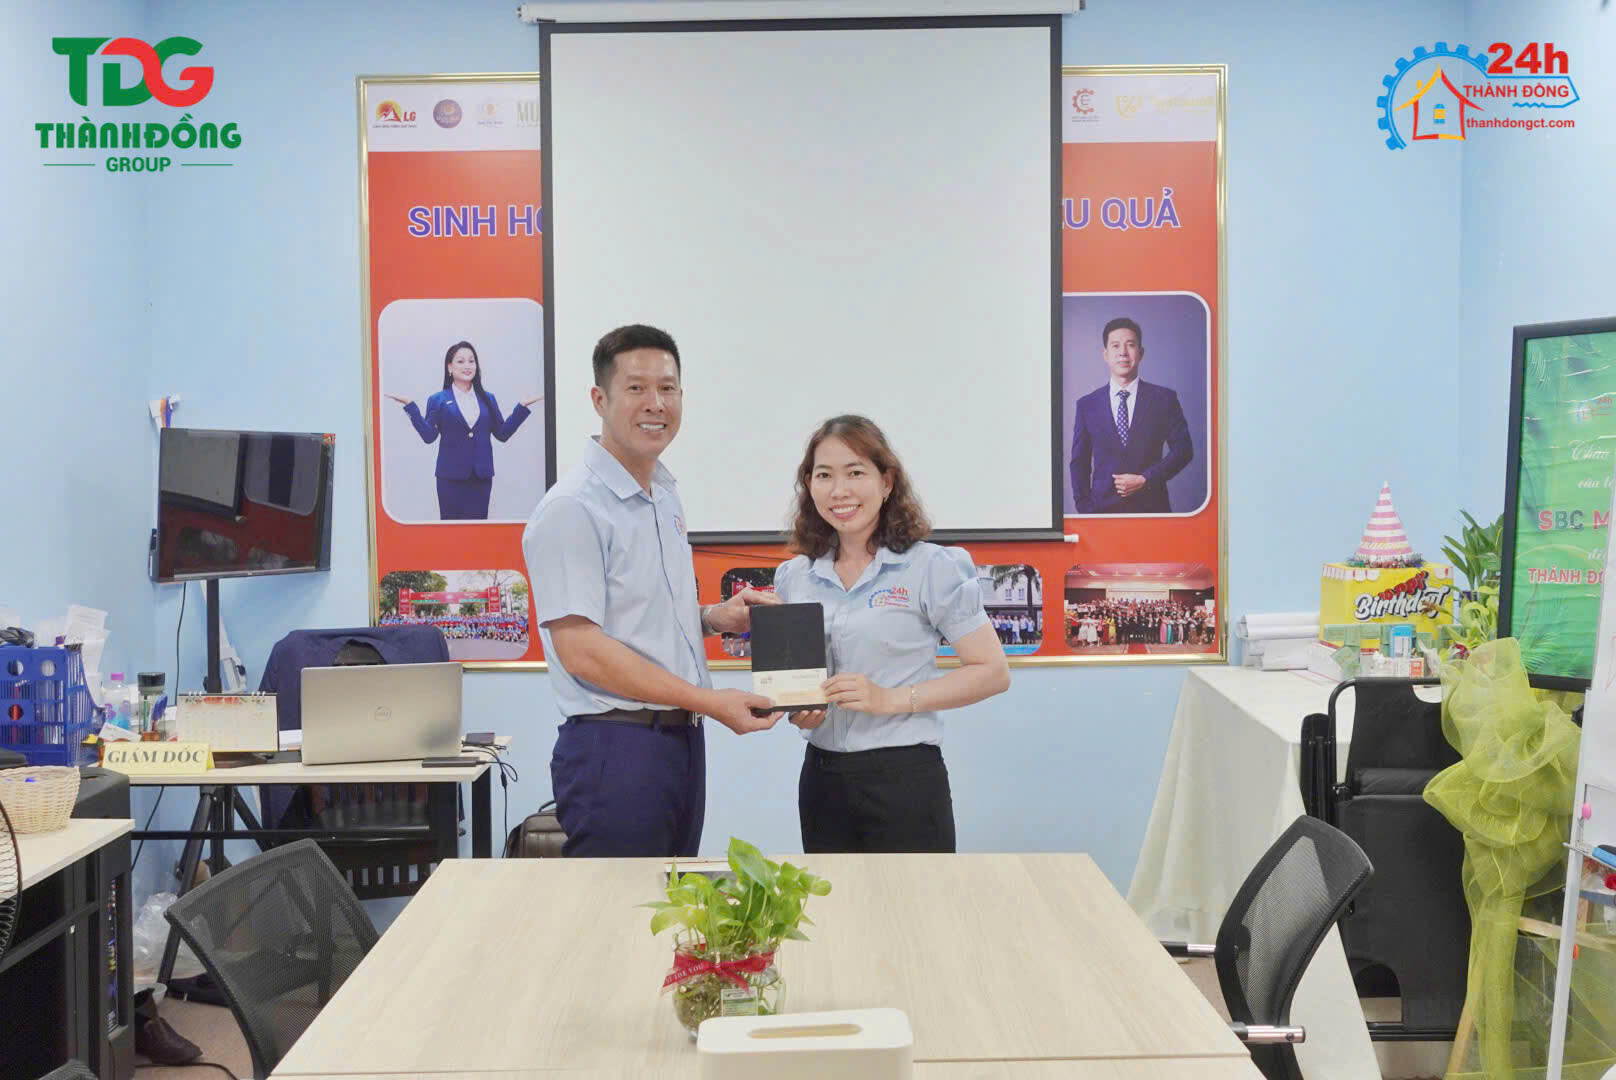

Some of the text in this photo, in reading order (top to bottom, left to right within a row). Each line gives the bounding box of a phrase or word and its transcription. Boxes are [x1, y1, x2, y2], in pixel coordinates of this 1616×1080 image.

[408, 205, 496, 238] SINH
[507, 204, 543, 237] H
[1101, 186, 1182, 231] QUẢ
[1538, 509, 1585, 531] SBC
[107, 747, 157, 764] GIÁM
